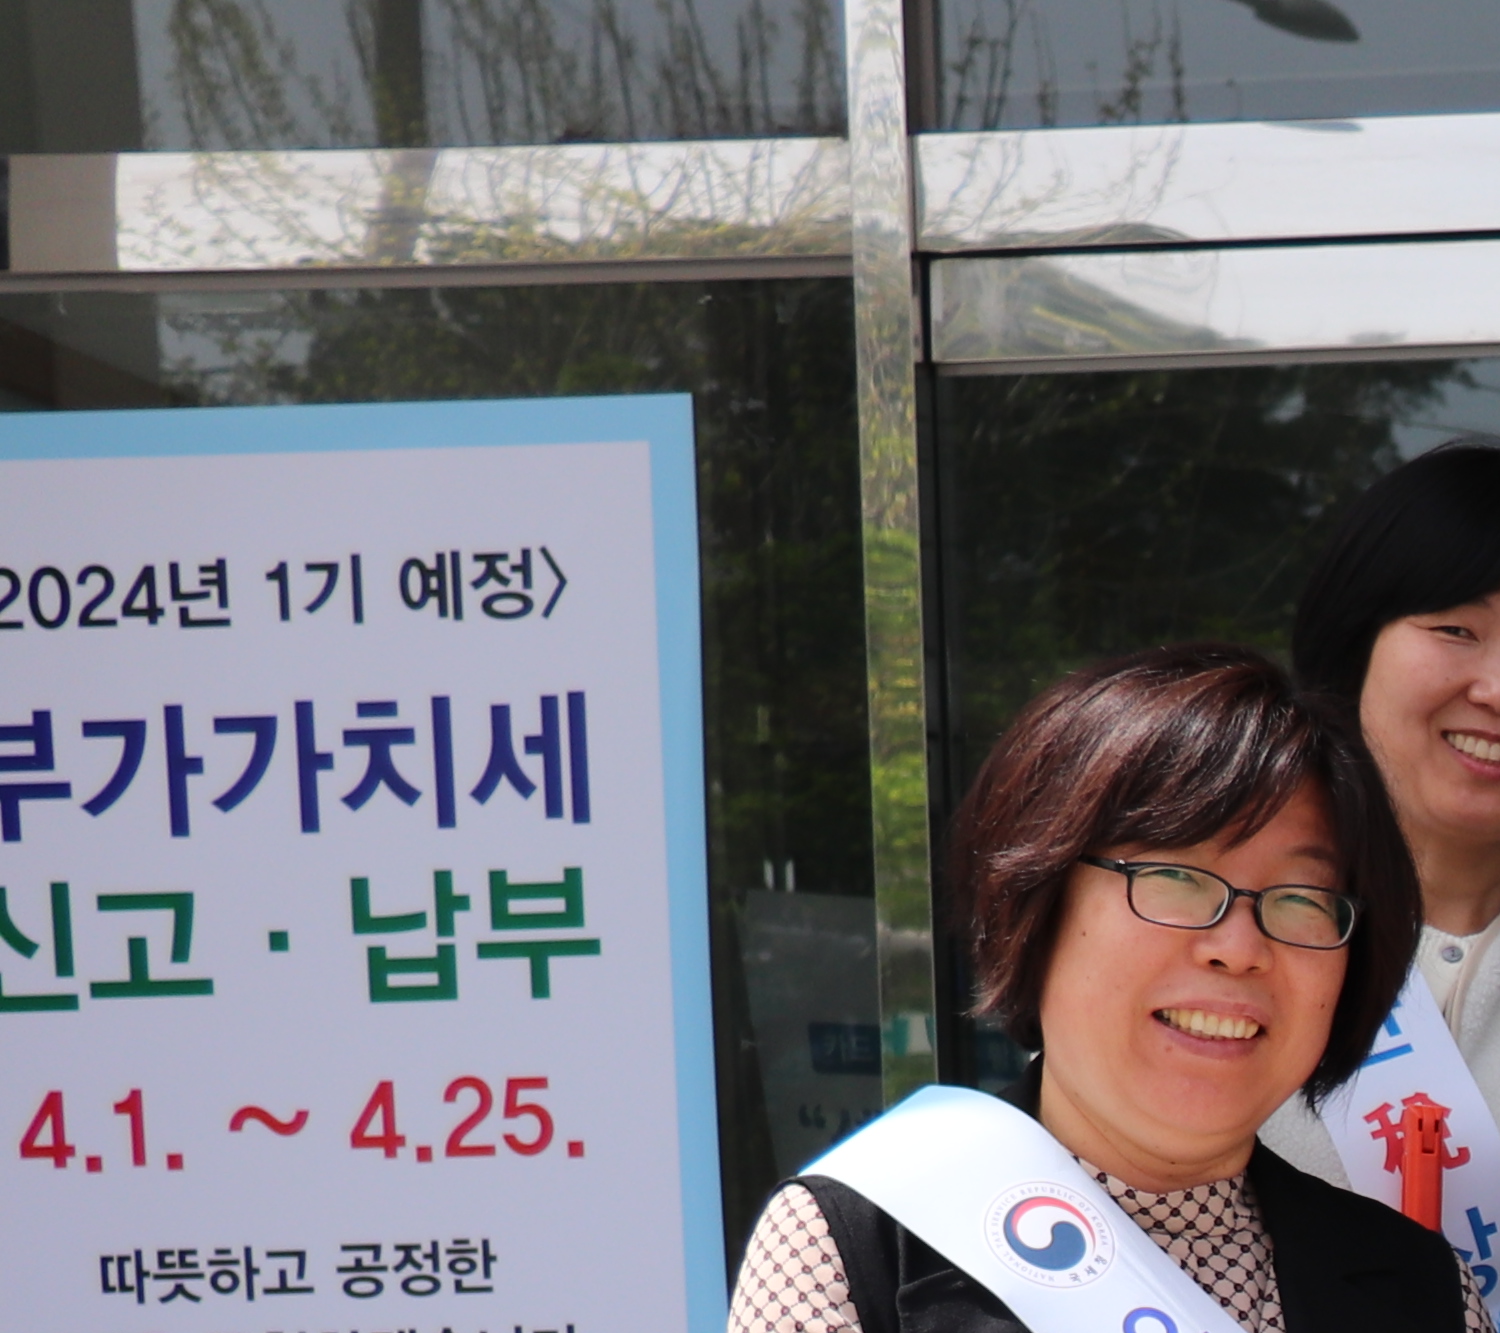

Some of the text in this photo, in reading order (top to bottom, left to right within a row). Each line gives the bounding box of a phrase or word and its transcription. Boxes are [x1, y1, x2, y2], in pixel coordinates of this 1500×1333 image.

[0, 557, 232, 630] 2024년
[265, 552, 365, 626] 1기
[0, 690, 591, 844] 부가가치세
[0, 880, 215, 1014] 신고
[349, 866, 602, 1004] 납부
[19, 1088, 184, 1174] 4.1.
[349, 1075, 585, 1163] 4.25.
[1020, 1186, 1076, 1202] REPUBLIC
[99, 1238, 498, 1306] 따뜻하고 공정한
